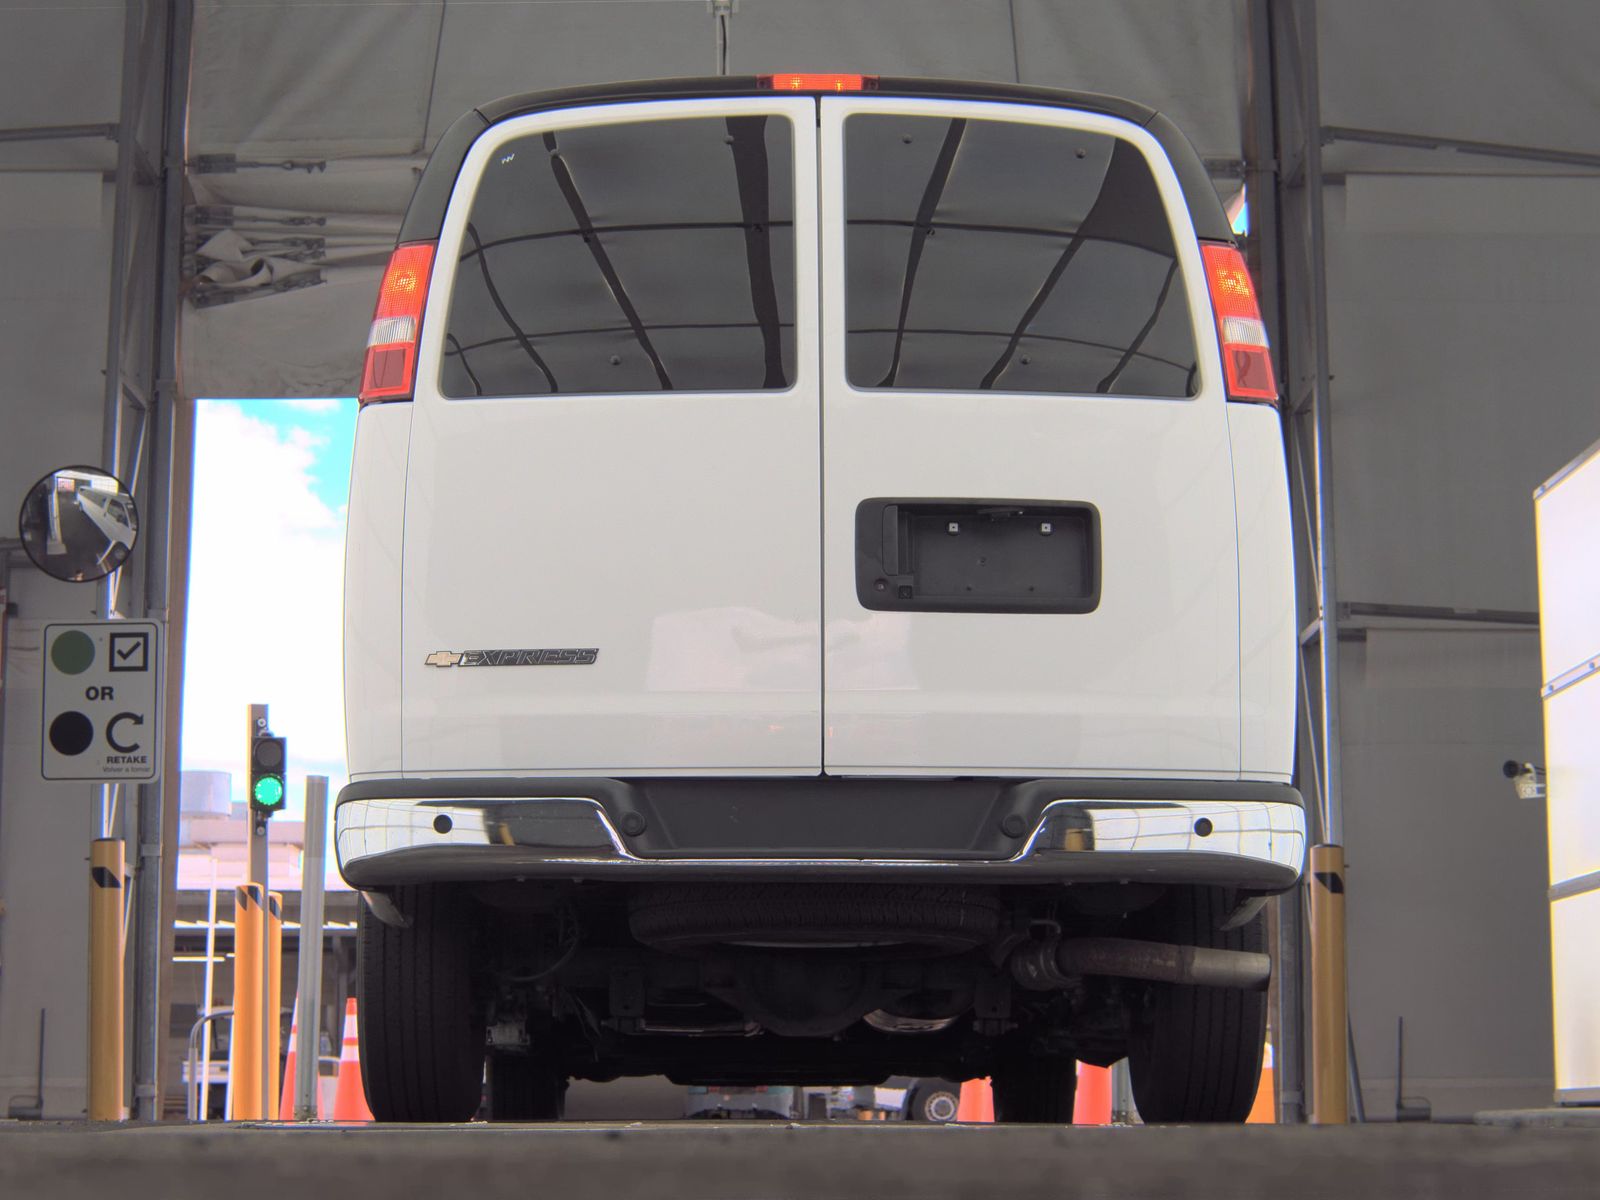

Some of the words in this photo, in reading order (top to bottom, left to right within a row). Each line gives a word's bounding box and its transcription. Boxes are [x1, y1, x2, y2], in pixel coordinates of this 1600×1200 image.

[459, 648, 599, 667] EXPRESS
[85, 686, 114, 701] OR
[106, 755, 147, 764] RETAKE
